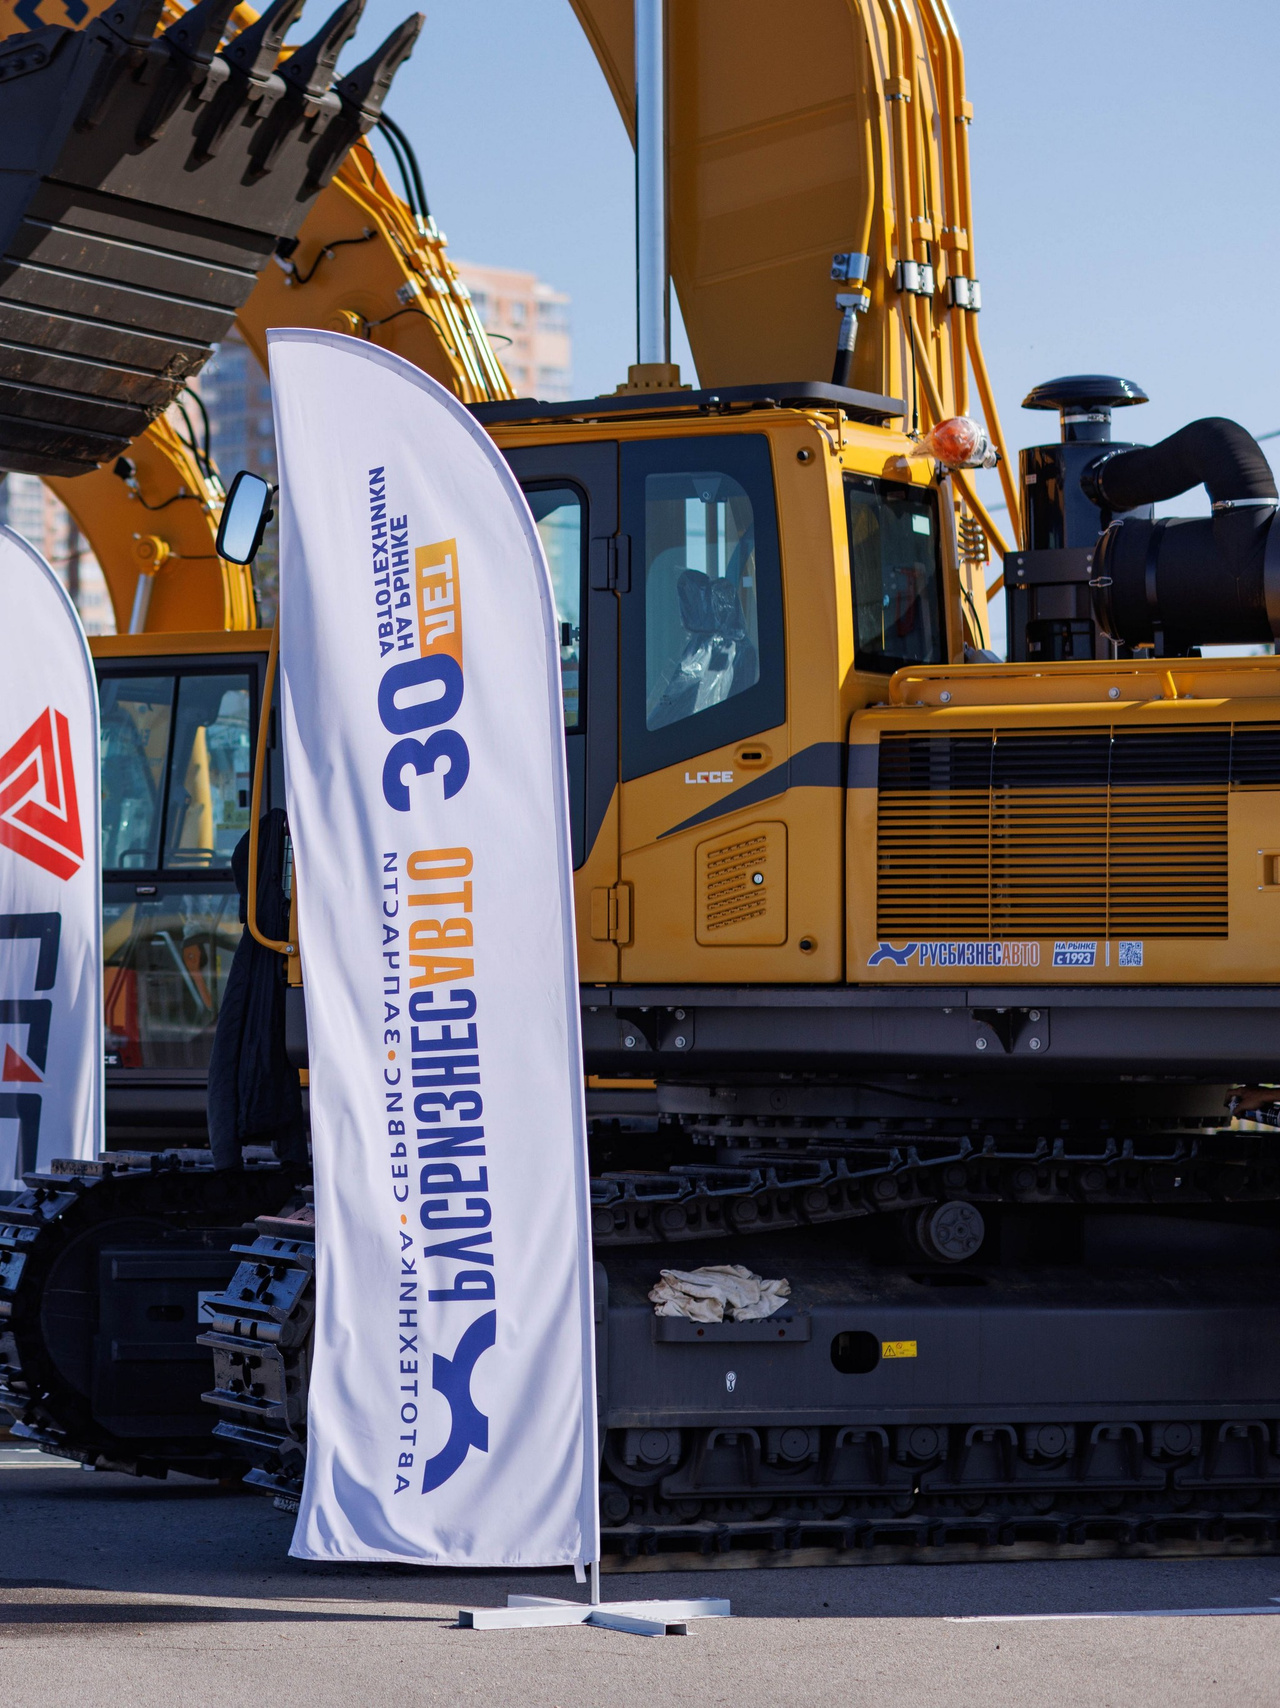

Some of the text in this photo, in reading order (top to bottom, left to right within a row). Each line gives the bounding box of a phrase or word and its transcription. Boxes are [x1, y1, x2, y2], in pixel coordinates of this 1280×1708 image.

[919, 942, 1040, 966] РУСБИЗНЕСАВТО
[1056, 942, 1096, 950] НА РЫНКЕ
